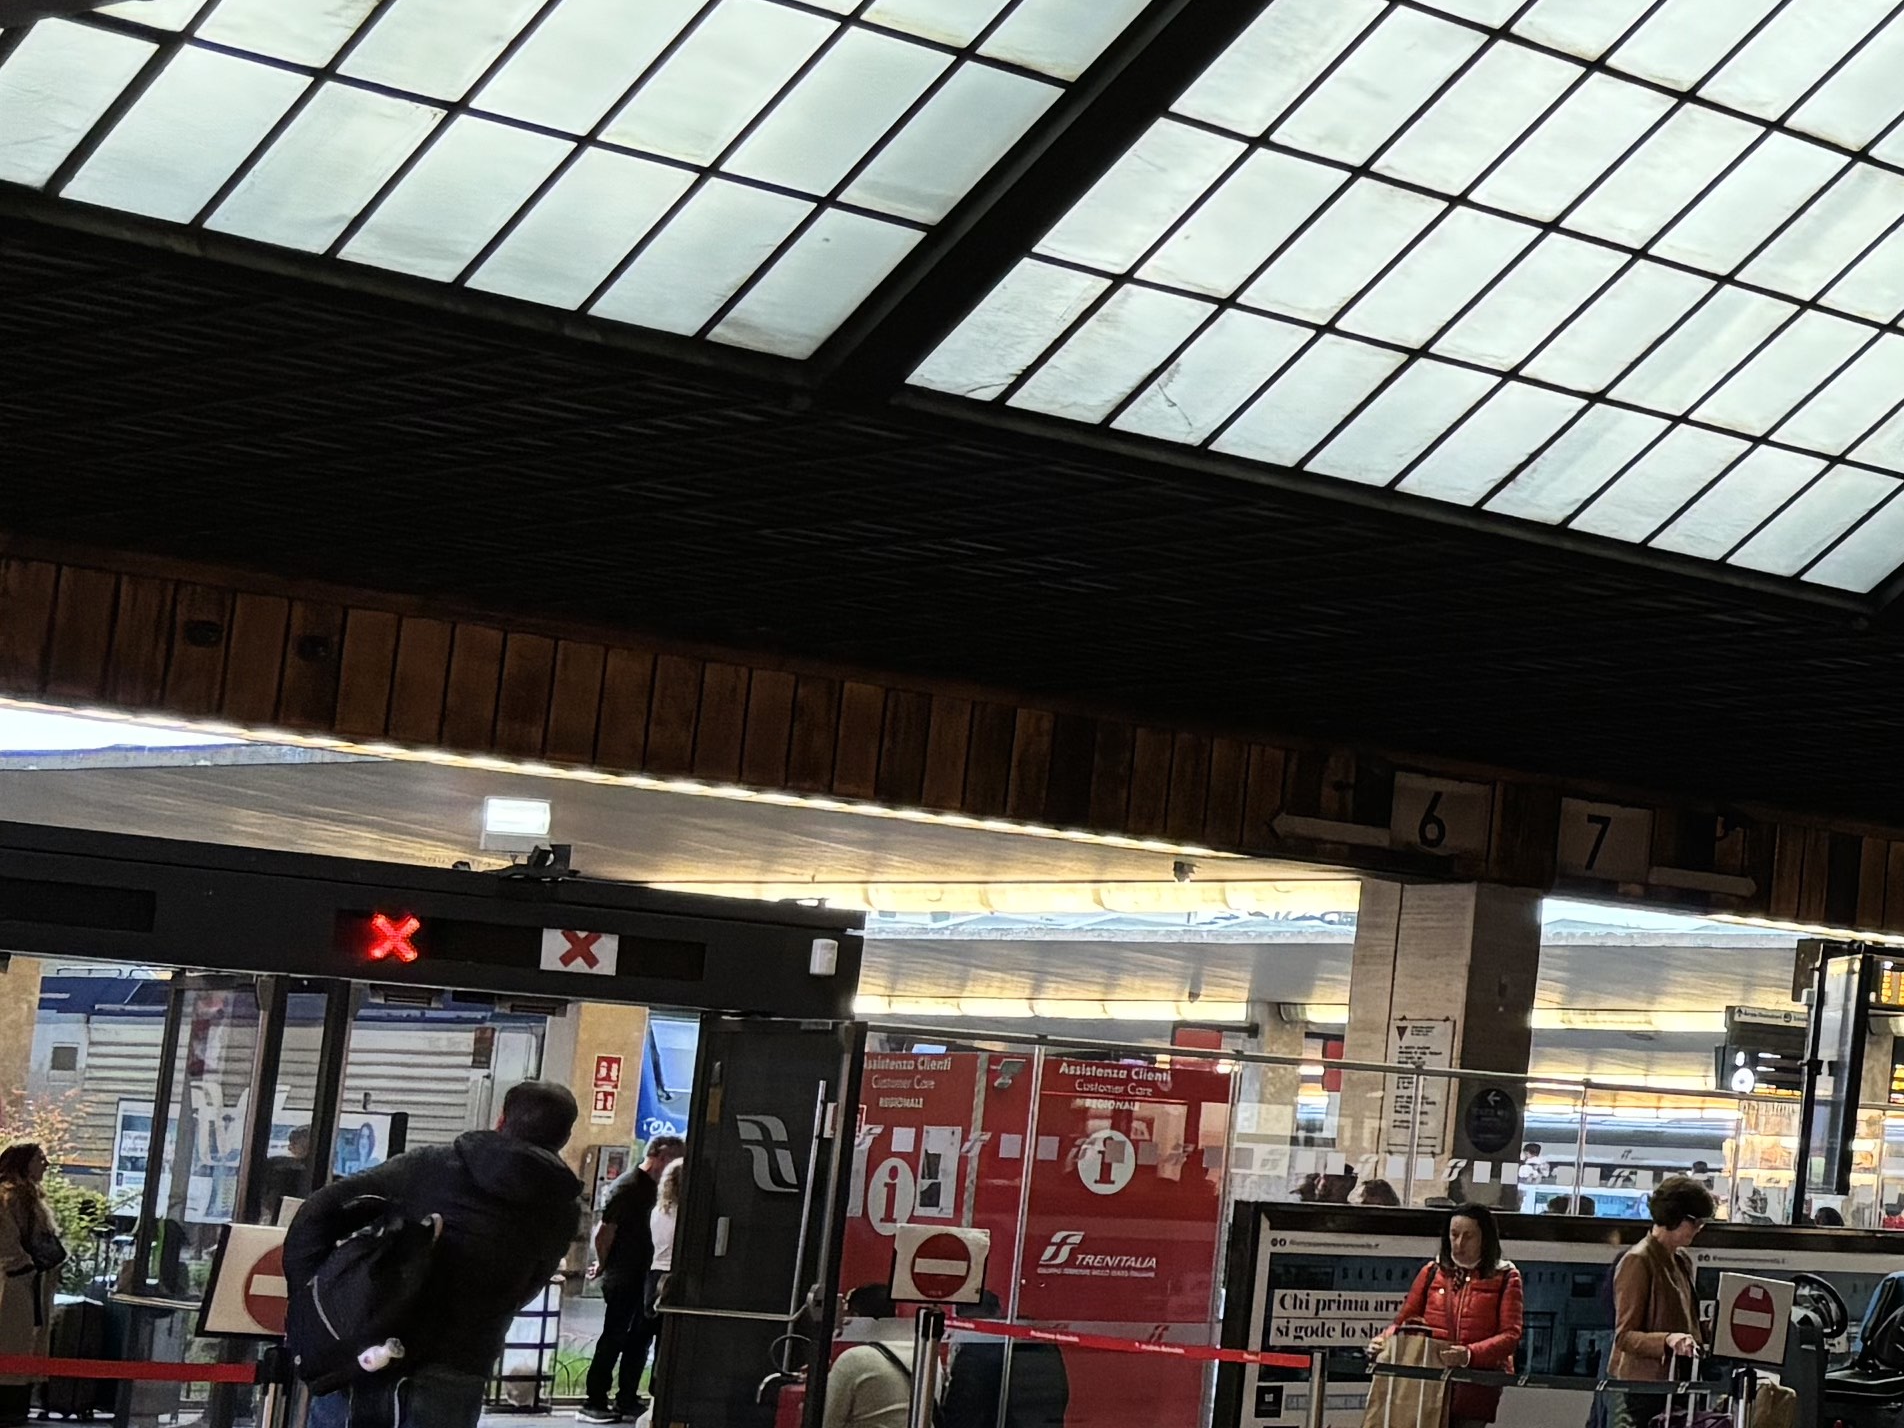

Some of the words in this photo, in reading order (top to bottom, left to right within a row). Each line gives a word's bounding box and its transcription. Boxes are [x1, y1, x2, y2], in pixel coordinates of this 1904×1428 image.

[1418, 791, 1446, 849] 6
[1586, 814, 1612, 871] 7
[1060, 1061, 1128, 1079] Assistenza
[1131, 1067, 1172, 1082] Clienti
[1127, 1082, 1153, 1097] Care
[1084, 1098, 1141, 1112] REGIONALE
[1075, 1254, 1157, 1269] TRENITALIA
[1279, 1292, 1310, 1311] Chi
[1315, 1293, 1369, 1316] prima
[1275, 1319, 1290, 1338] si
[1294, 1320, 1336, 1341] gode
[1340, 1322, 1356, 1339] lo
